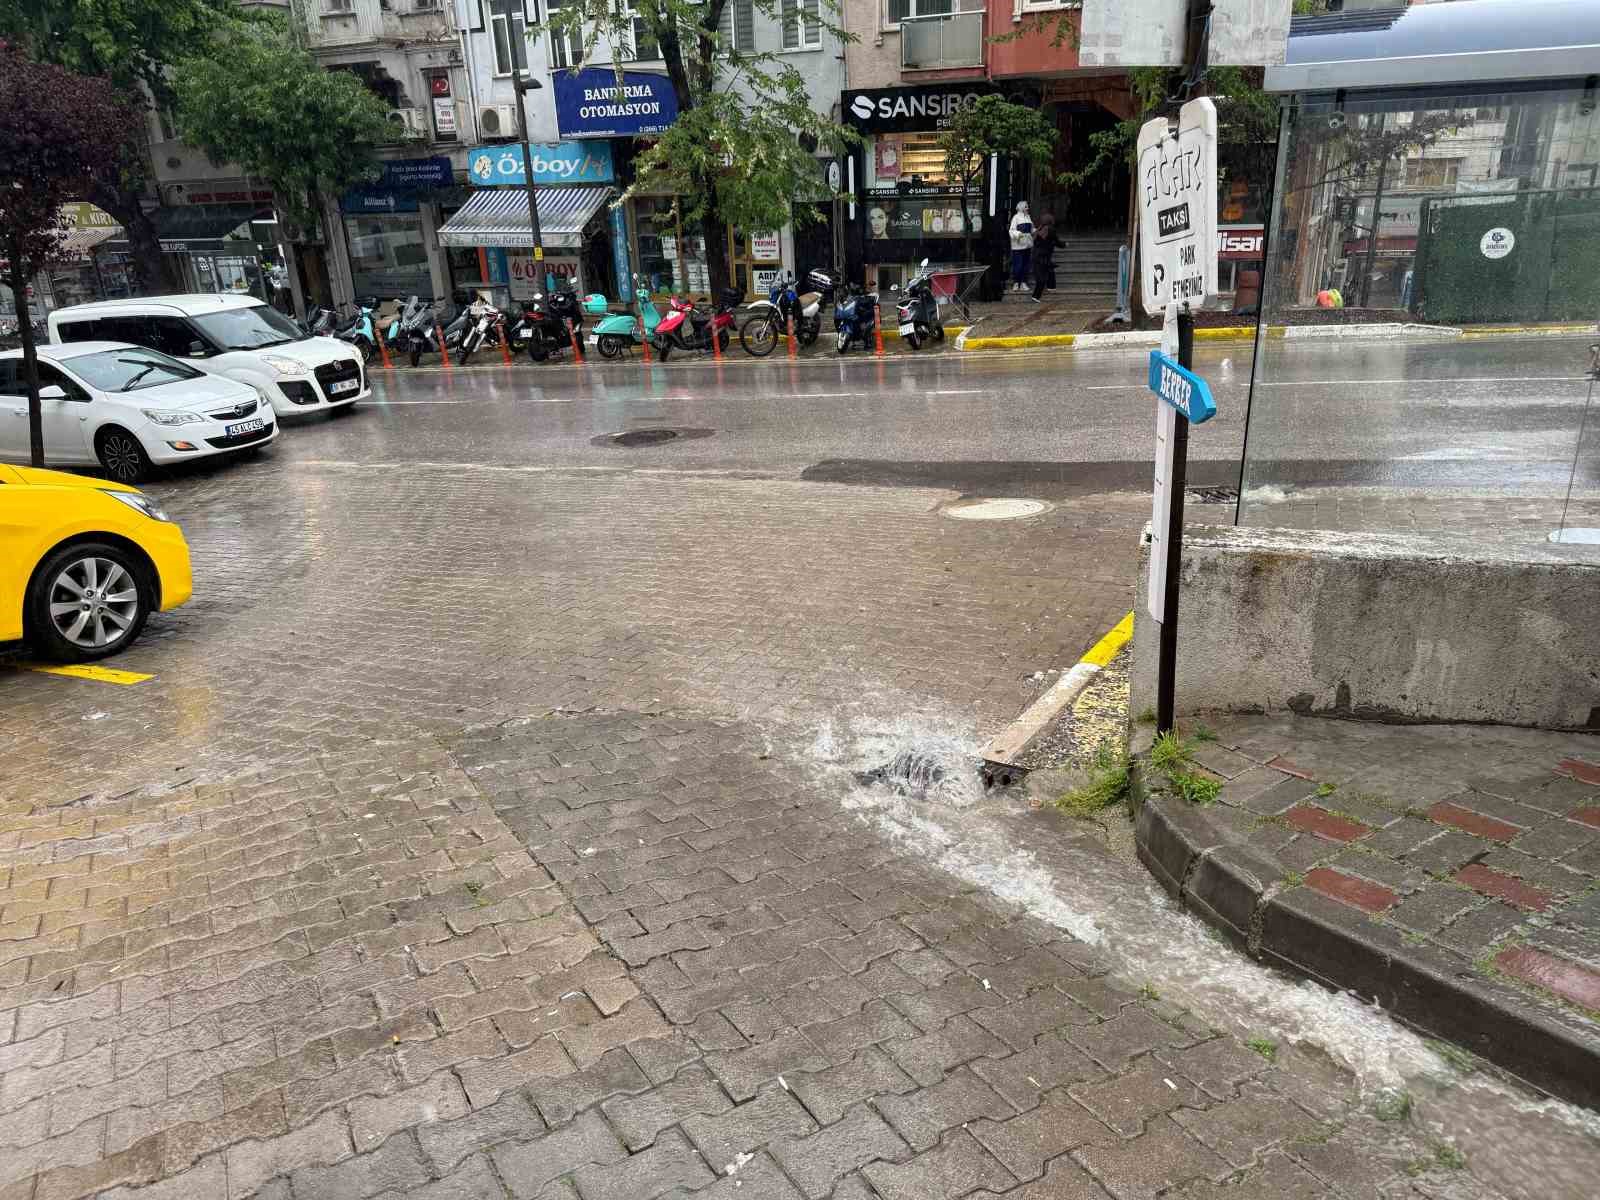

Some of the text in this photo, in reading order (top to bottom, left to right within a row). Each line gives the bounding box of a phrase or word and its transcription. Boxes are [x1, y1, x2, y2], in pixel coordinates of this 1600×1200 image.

[580, 102, 660, 118] OTOMASYON
[1180, 244, 1196, 267] PARK
[525, 257, 578, 278] ÖBOY
[1160, 365, 1192, 416] BERBER
